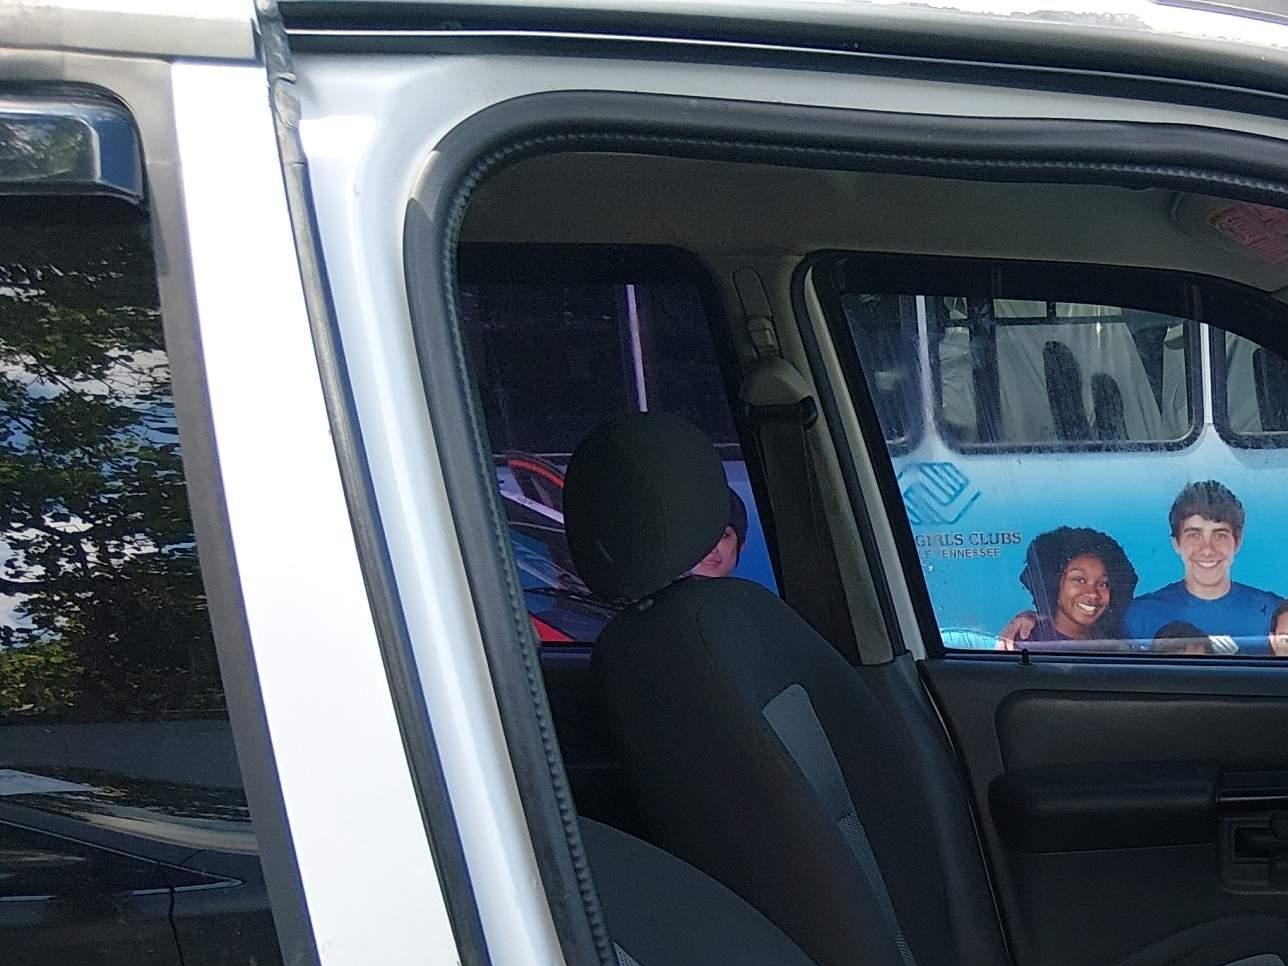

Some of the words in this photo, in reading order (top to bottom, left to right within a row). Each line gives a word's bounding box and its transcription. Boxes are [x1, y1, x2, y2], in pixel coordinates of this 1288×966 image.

[915, 534, 963, 547] GIRLS
[968, 532, 1021, 545] CLUBS
[937, 548, 1000, 559] ENNESSEE
